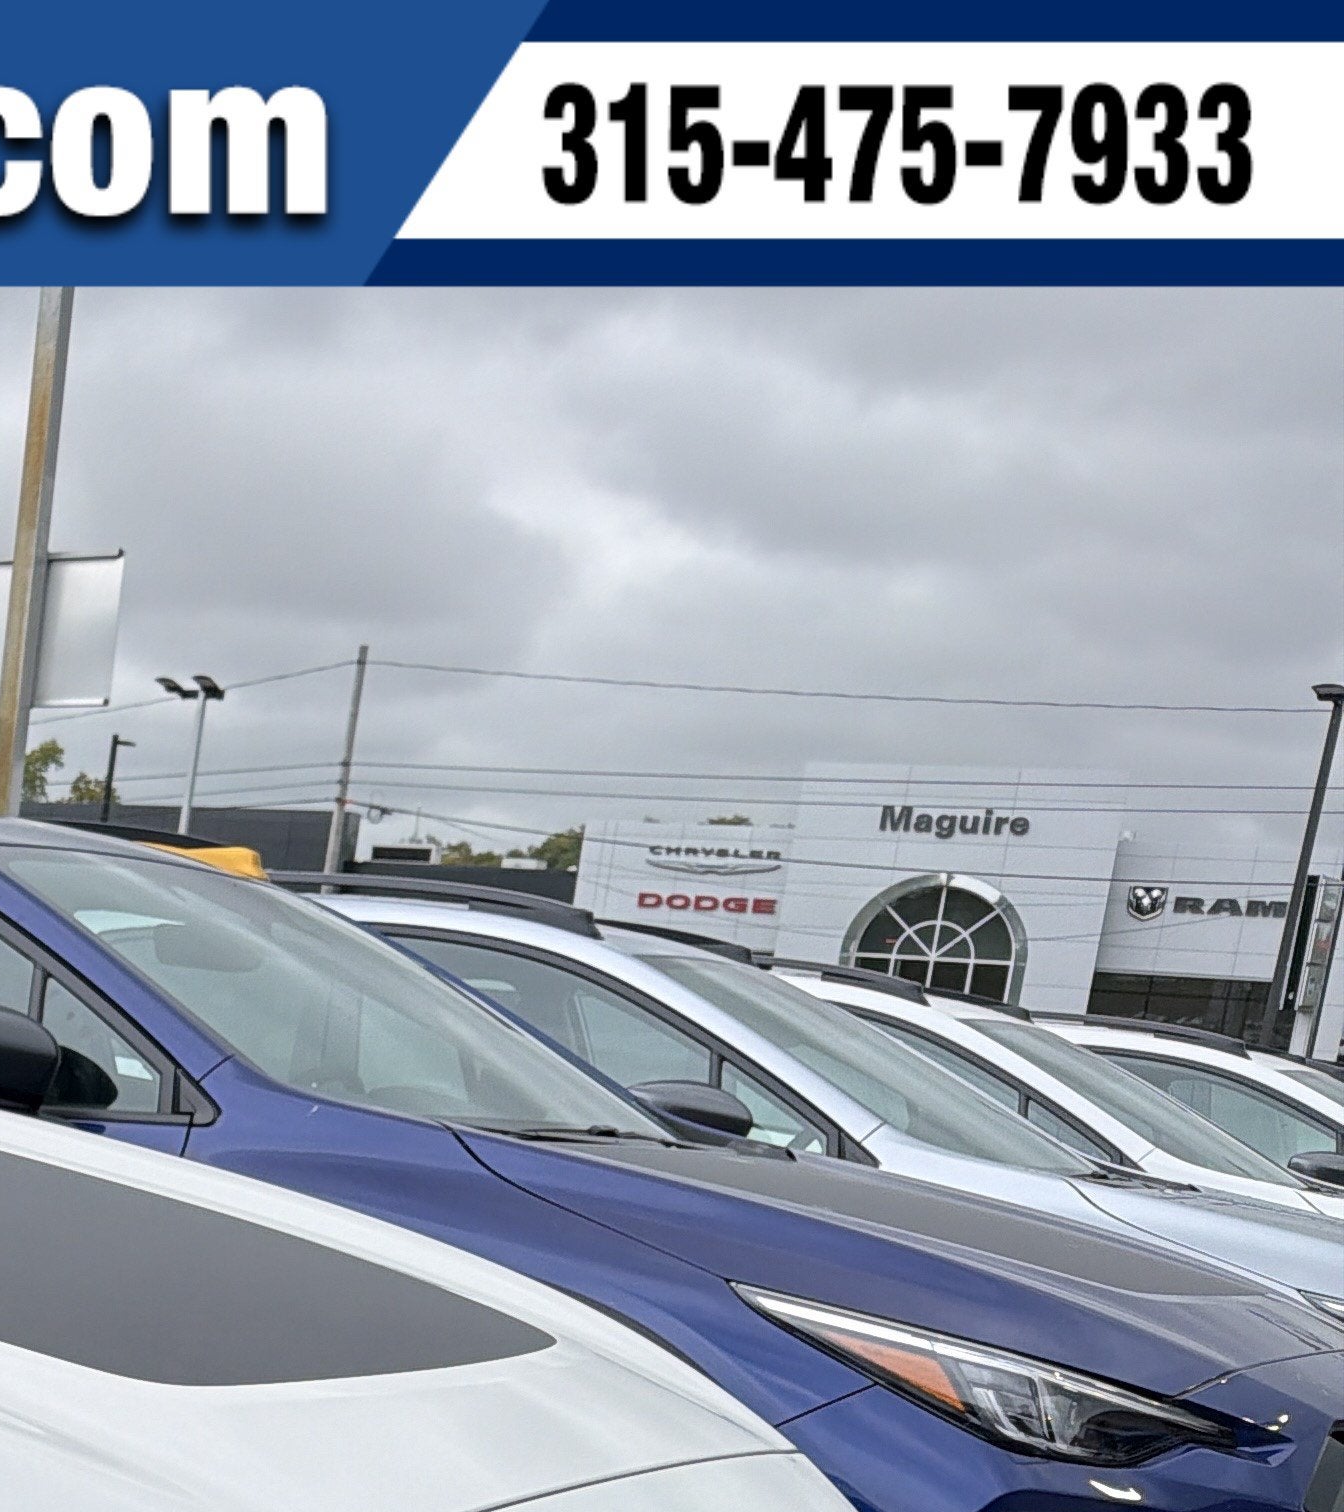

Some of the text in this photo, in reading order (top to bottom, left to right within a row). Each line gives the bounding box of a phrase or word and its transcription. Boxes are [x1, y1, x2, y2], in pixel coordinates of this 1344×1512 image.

[879, 805, 1030, 839] Maguire
[649, 845, 782, 860] CHRYSLER
[637, 892, 778, 916] DODGE
[1173, 896, 1289, 919] RAM
